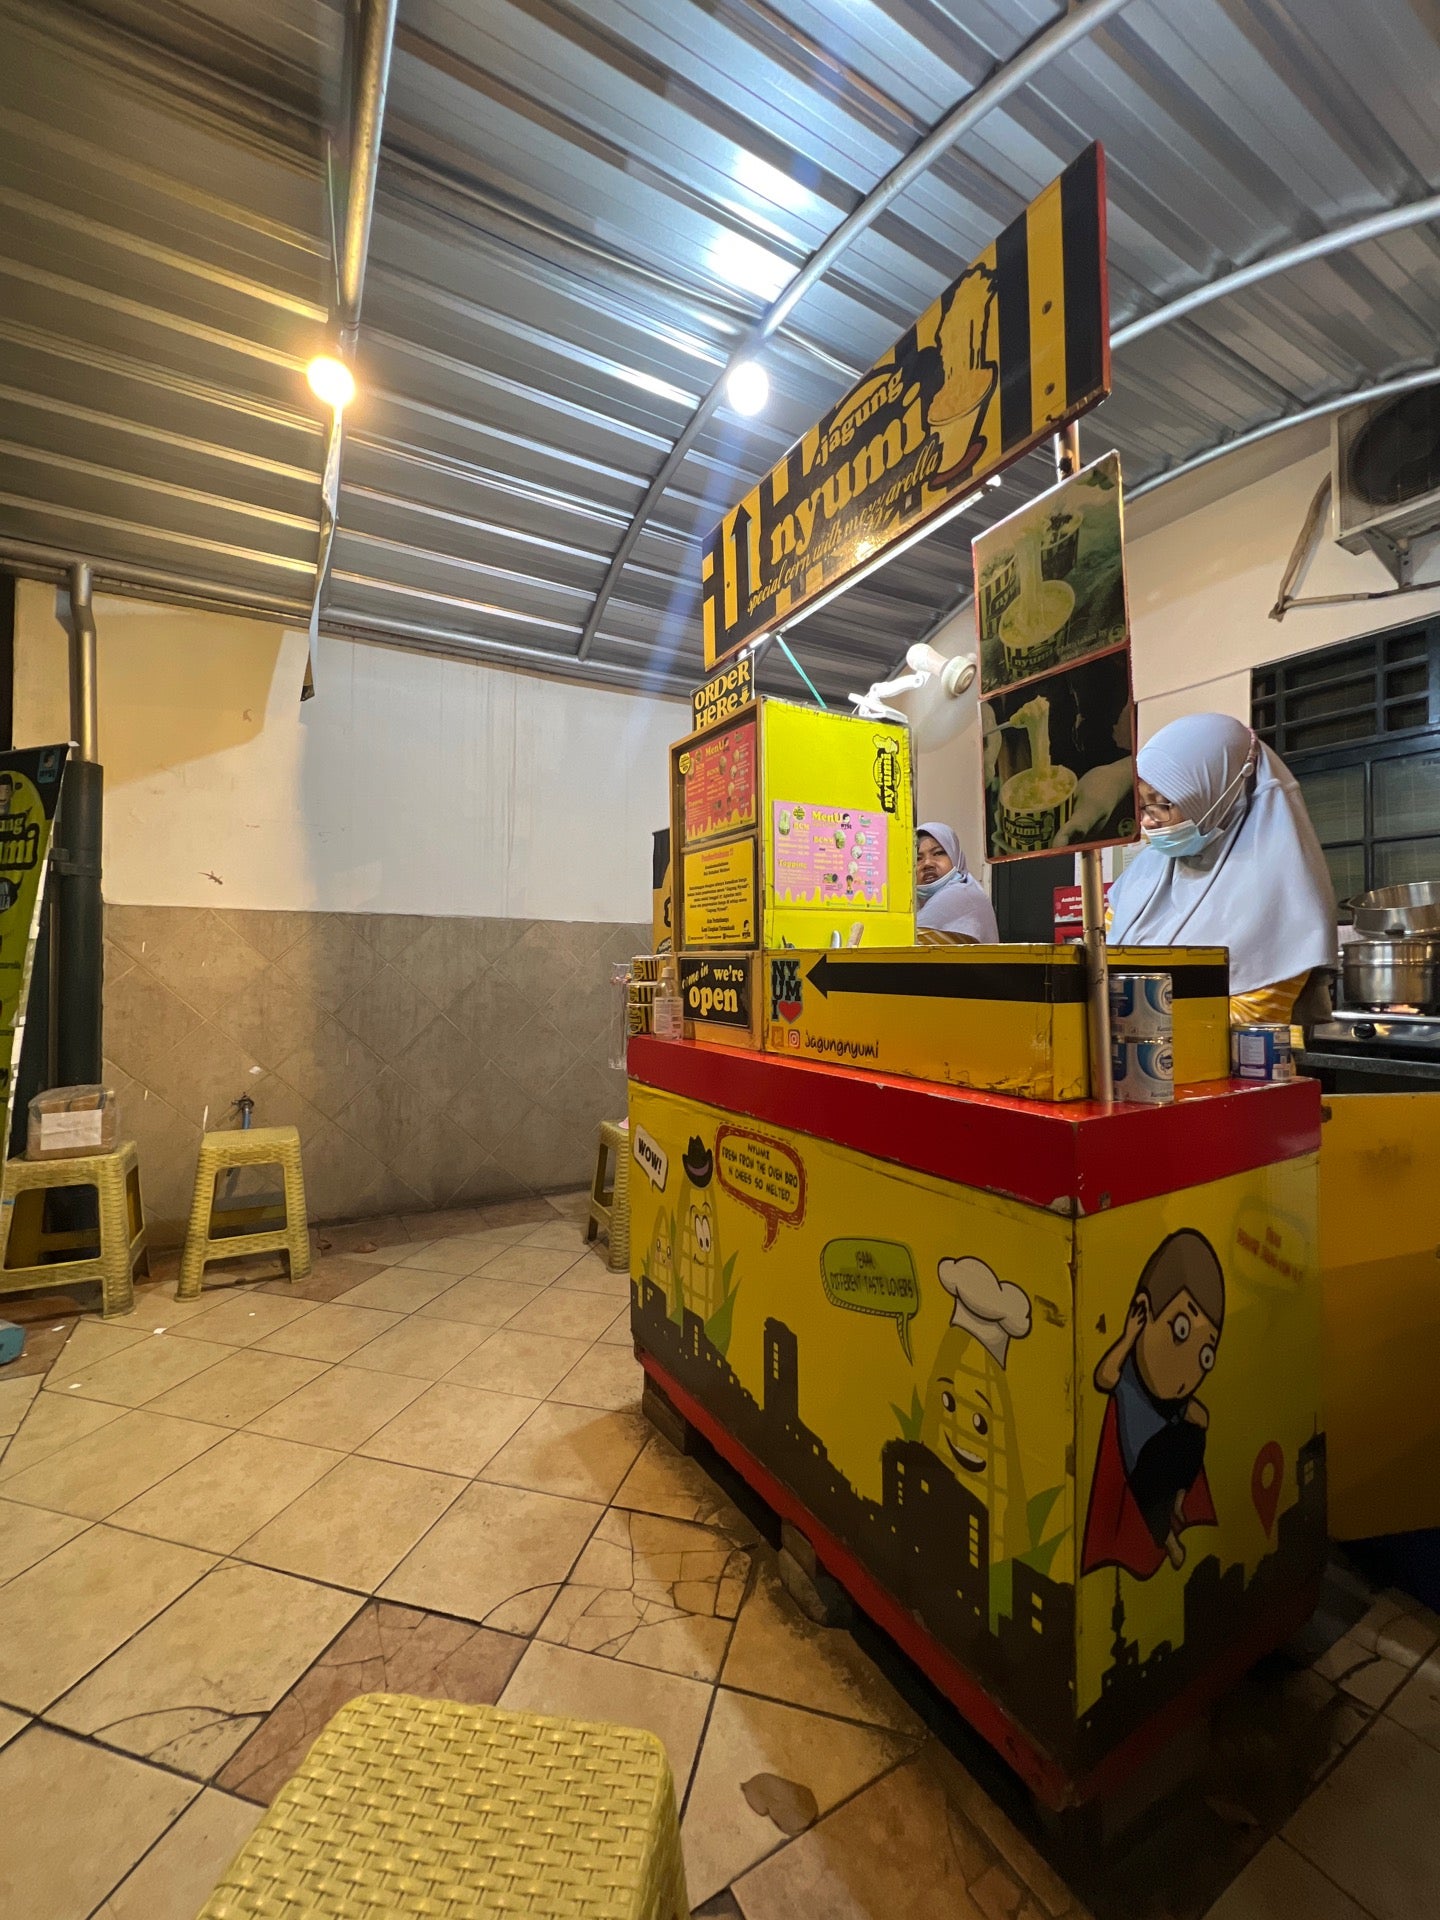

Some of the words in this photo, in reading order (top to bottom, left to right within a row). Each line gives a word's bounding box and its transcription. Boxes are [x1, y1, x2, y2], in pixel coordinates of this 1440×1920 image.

[813, 367, 904, 468] jagung
[770, 382, 926, 565] nyumi
[747, 559, 787, 617] special
[785, 555, 813, 585] corn
[881, 753, 895, 809] nyumi
[1005, 821, 1041, 837] nyumi
[700, 961, 709, 978] in
[713, 965, 744, 982] we're
[771, 960, 801, 981] NY
[689, 984, 738, 1017] open
[771, 981, 802, 1002] UM
[638, 1137, 662, 1176] WOW!
[722, 1146, 737, 1162] FRESH
[739, 1153, 755, 1170] FROM
[756, 1160, 766, 1175] THE
[785, 1172, 798, 1189] BRO
[747, 1143, 770, 1161] NYUMI
[754, 1177, 764, 1190] SO
